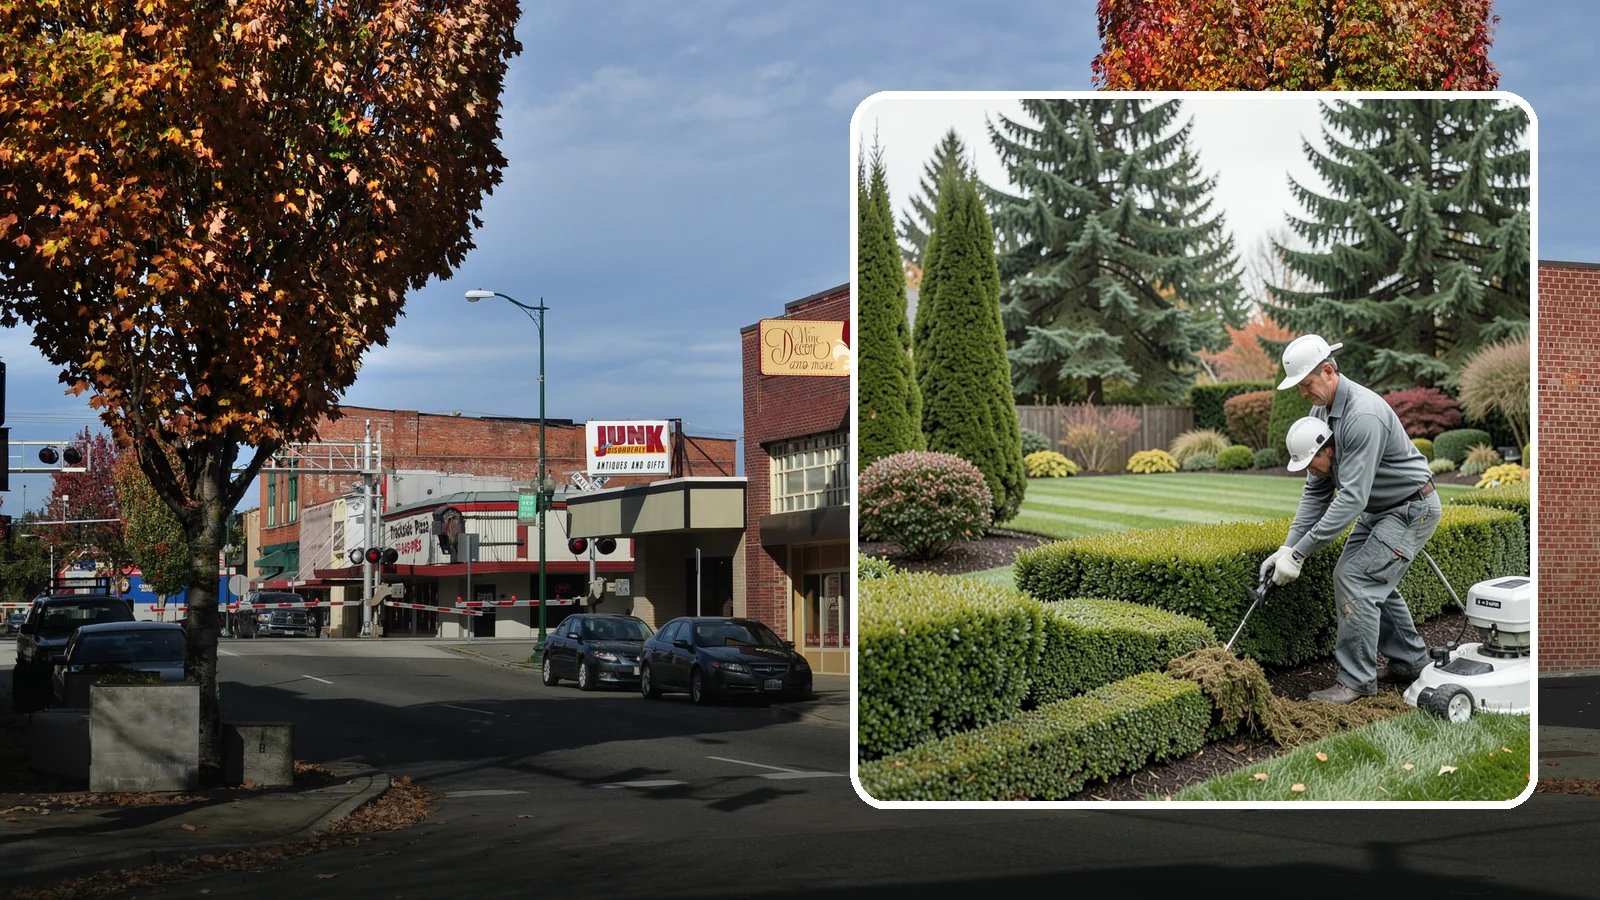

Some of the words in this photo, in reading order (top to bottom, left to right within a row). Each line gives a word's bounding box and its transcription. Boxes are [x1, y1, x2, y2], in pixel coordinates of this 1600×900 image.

[791, 325, 823, 345] Wine
[595, 425, 665, 457] JUNK
[597, 461, 628, 470] ANTIQUES
[631, 461, 643, 470] AND
[647, 461, 665, 469] GIFTS
[352, 498, 365, 510] CRO
[415, 520, 429, 534] Pizza
